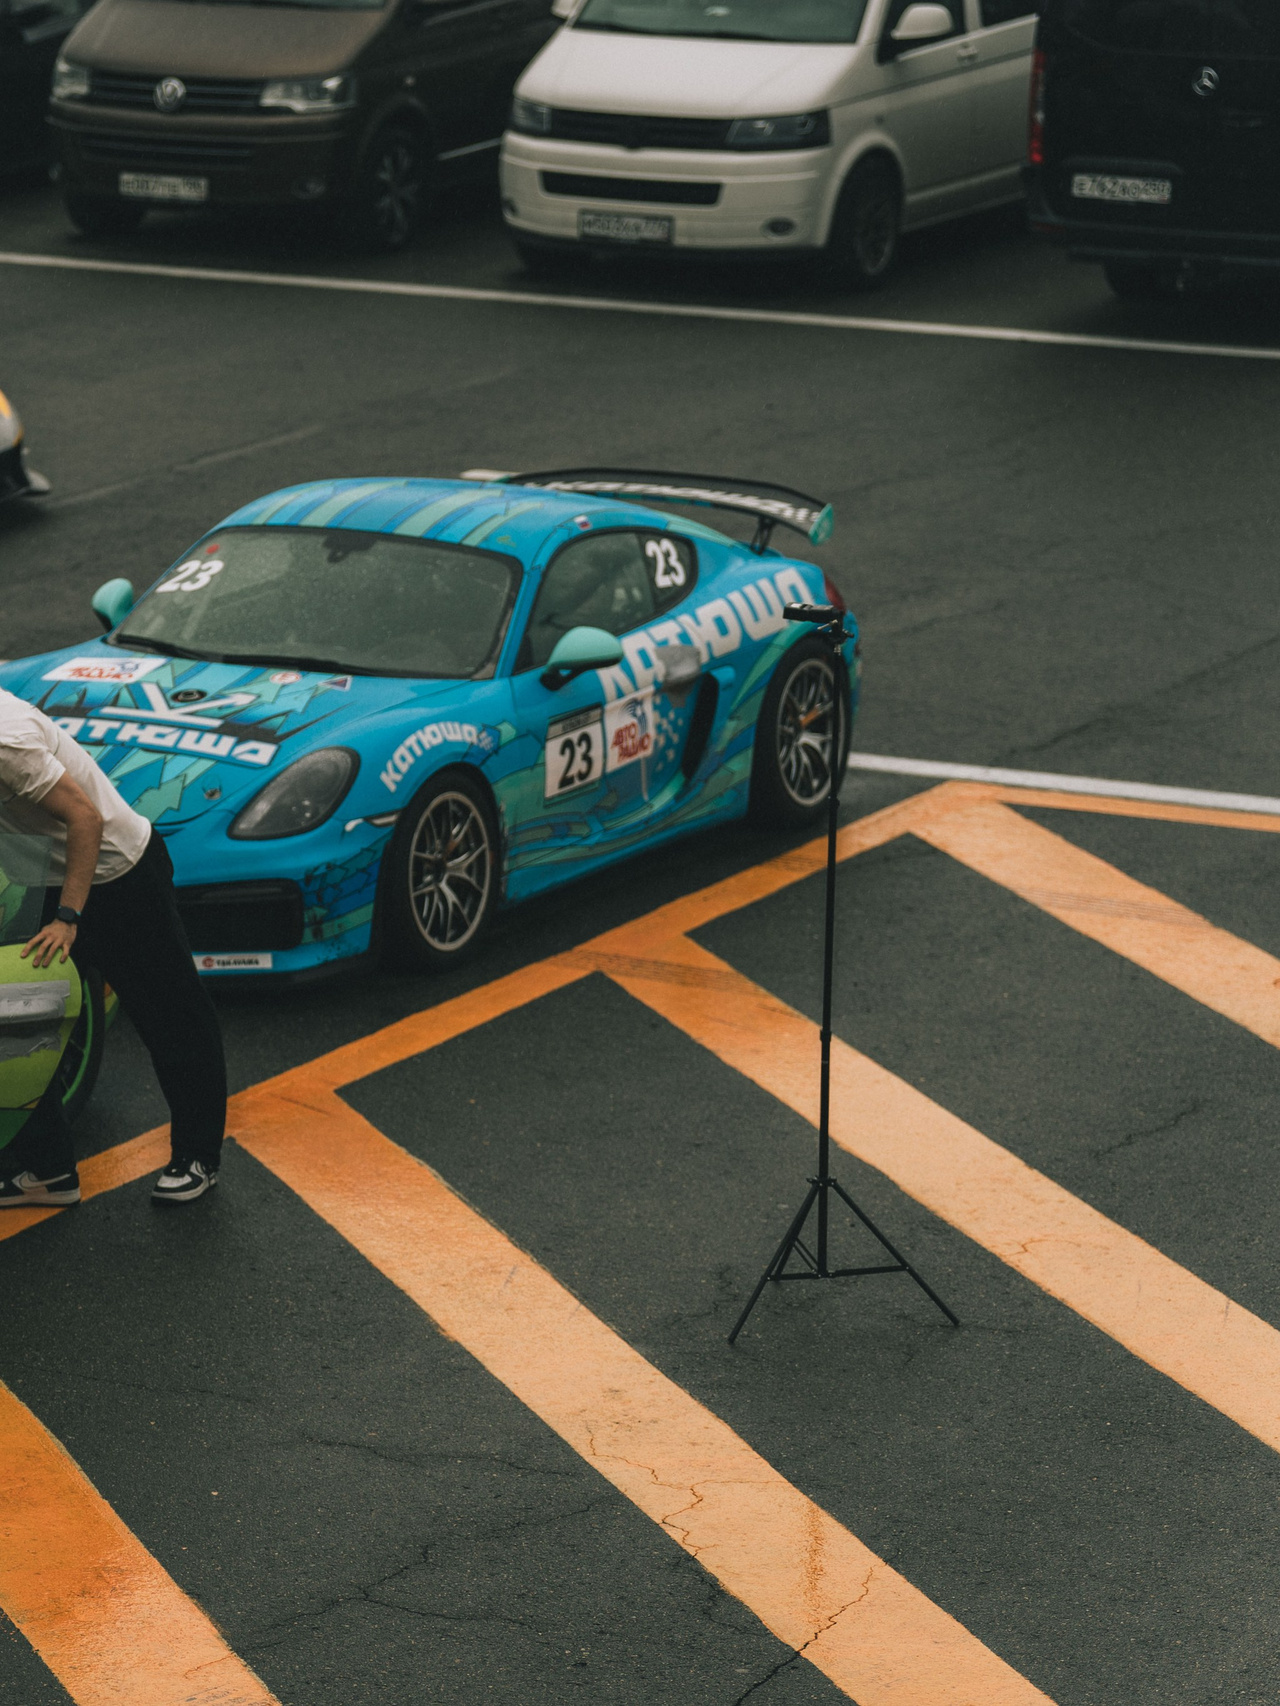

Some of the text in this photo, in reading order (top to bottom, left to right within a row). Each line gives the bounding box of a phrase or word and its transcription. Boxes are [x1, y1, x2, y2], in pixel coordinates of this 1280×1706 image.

[155, 559, 224, 593] 23
[645, 538, 686, 588] 23
[558, 731, 593, 790] 23
